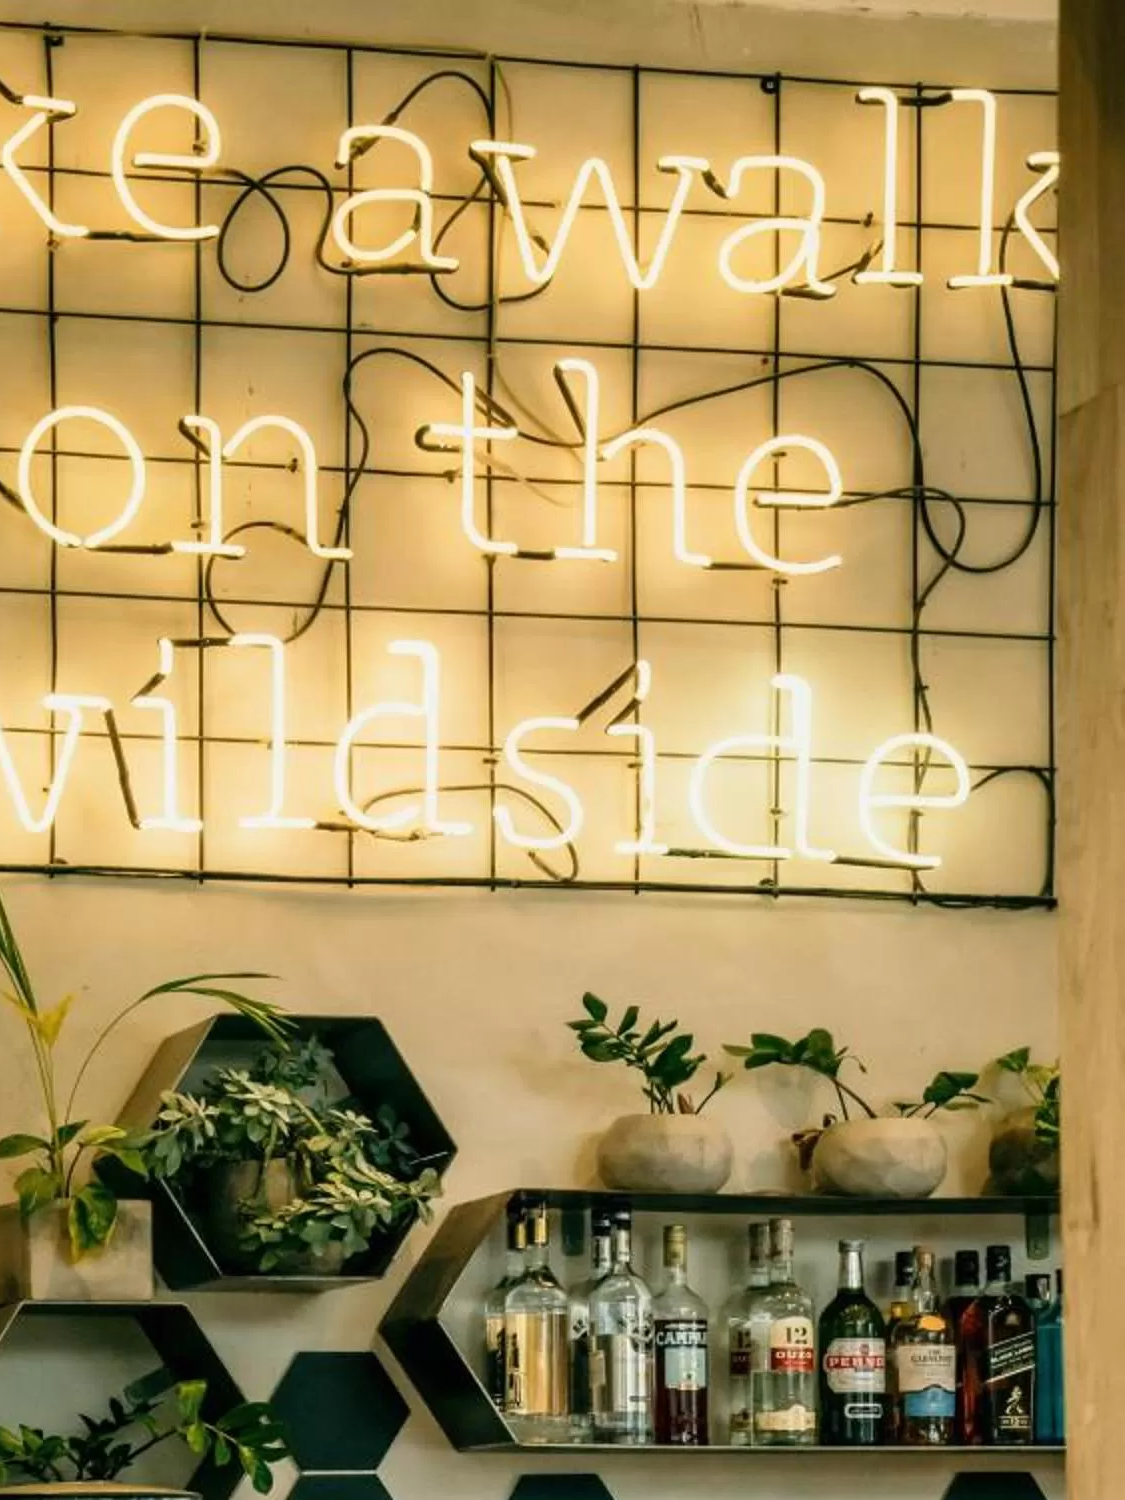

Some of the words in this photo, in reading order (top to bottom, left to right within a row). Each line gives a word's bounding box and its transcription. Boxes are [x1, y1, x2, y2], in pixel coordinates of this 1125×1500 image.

[16, 404, 354, 560] on
[421, 358, 844, 577] the
[785, 1326, 809, 1345] 12
